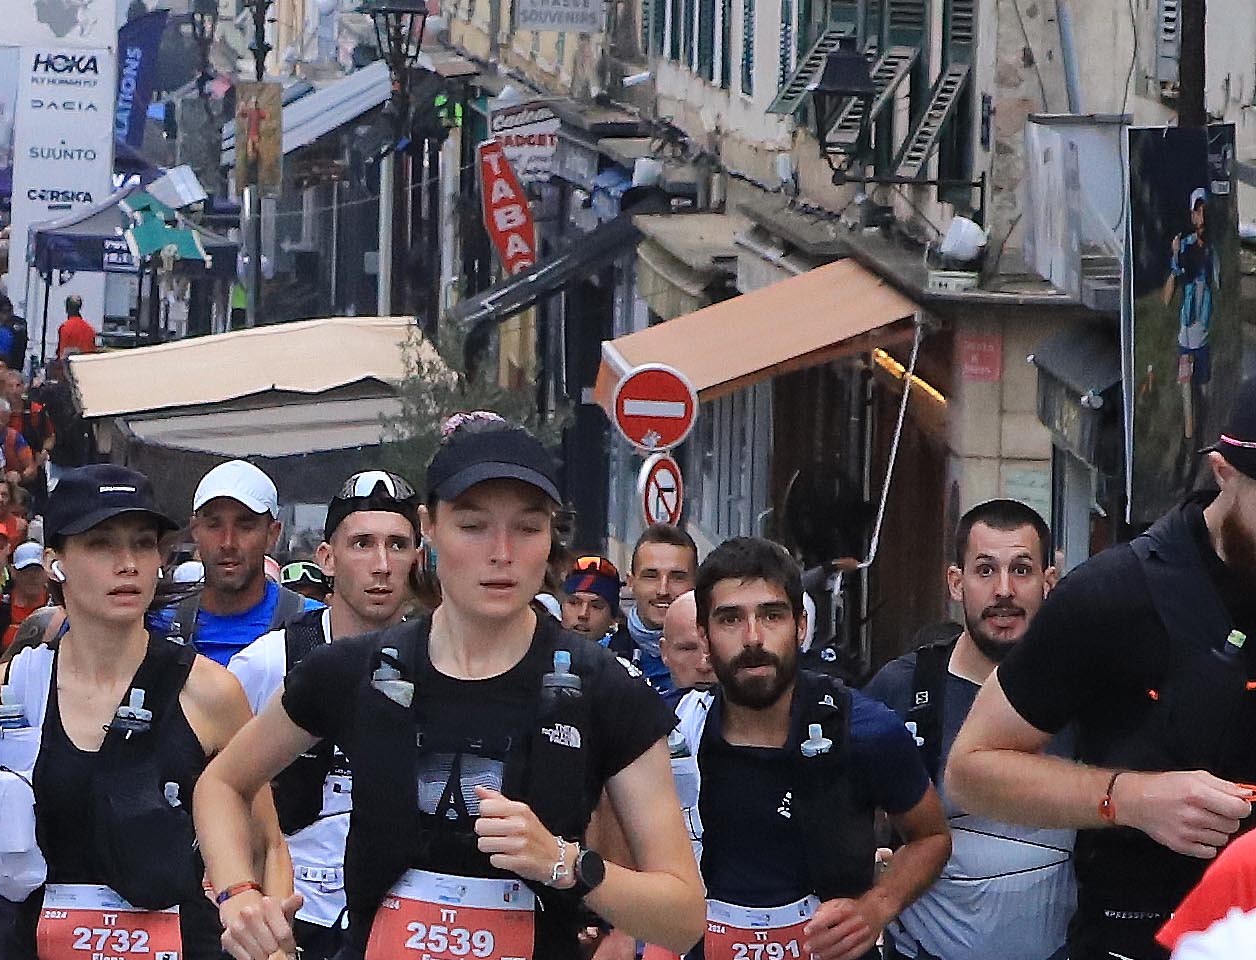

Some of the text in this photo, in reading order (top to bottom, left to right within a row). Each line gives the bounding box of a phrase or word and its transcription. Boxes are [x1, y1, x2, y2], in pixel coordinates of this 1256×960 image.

[32, 53, 98, 75] HOKA
[31, 99, 98, 112] DACIA
[29, 147, 97, 161] SUUNTO
[102, 914, 118, 926] TT
[440, 909, 457, 923] TT
[72, 926, 150, 953] 2732
[404, 921, 495, 958] 2539
[754, 931, 768, 941] TT
